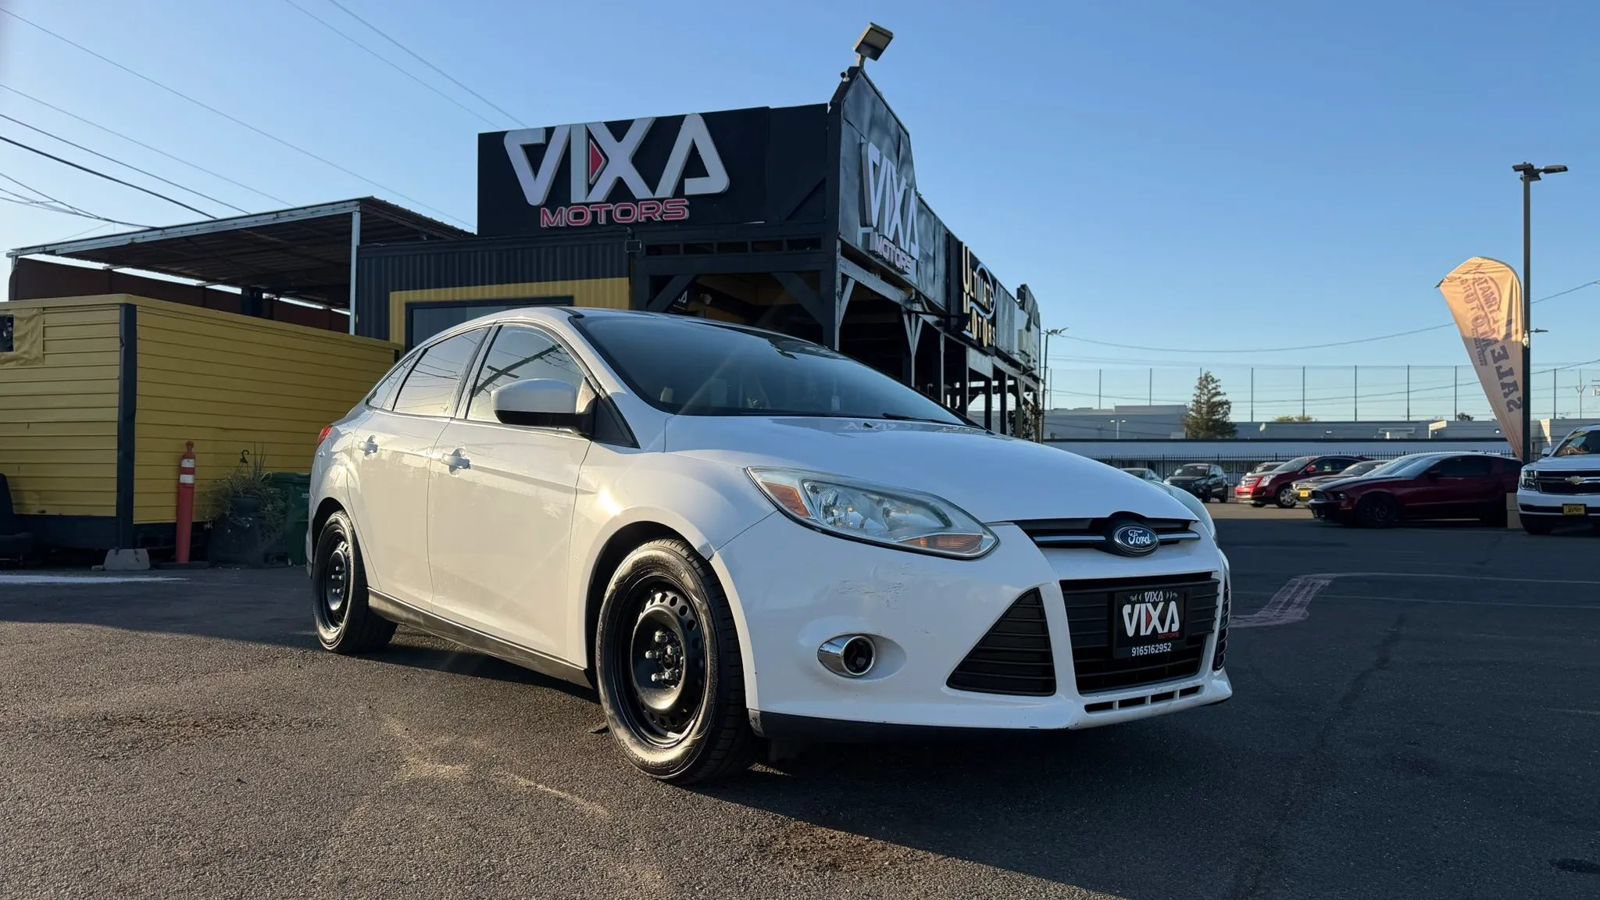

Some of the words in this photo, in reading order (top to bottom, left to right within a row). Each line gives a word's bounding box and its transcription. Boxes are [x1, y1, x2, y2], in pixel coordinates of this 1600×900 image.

[503, 113, 730, 206] VIXA
[540, 199, 690, 228] MOTORS
[866, 141, 919, 260] VIXA
[873, 234, 915, 273] MOTORS
[1128, 529, 1150, 544] Ford
[1145, 591, 1164, 602] VIXA
[1122, 600, 1180, 637] VIXA
[1131, 642, 1172, 656] 9165162952
